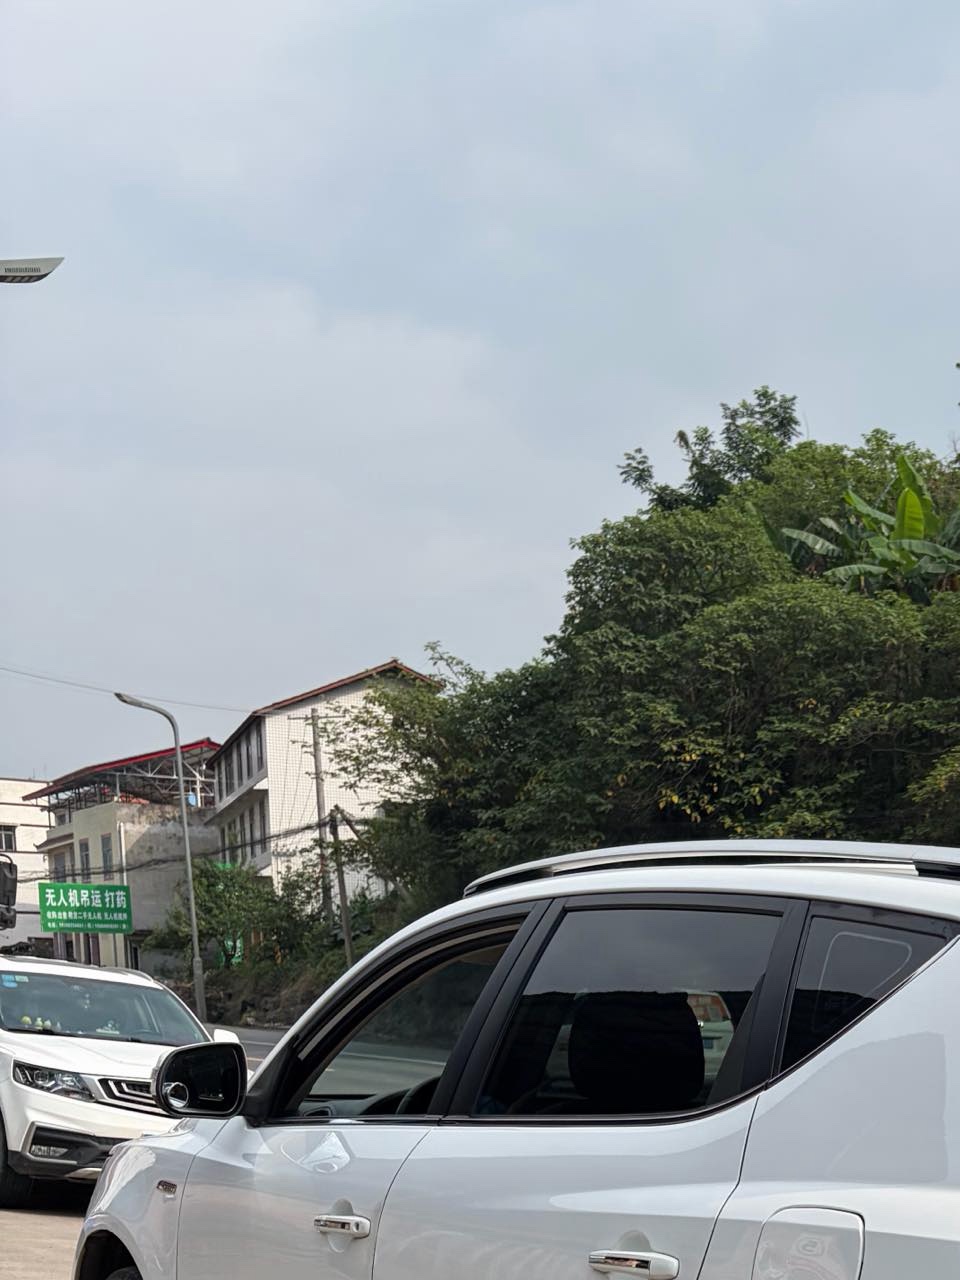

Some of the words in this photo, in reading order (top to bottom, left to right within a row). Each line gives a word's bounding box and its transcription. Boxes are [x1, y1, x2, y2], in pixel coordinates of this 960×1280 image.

[45, 888, 102, 907] 无人机吊运
[104, 889, 126, 908] 打药
